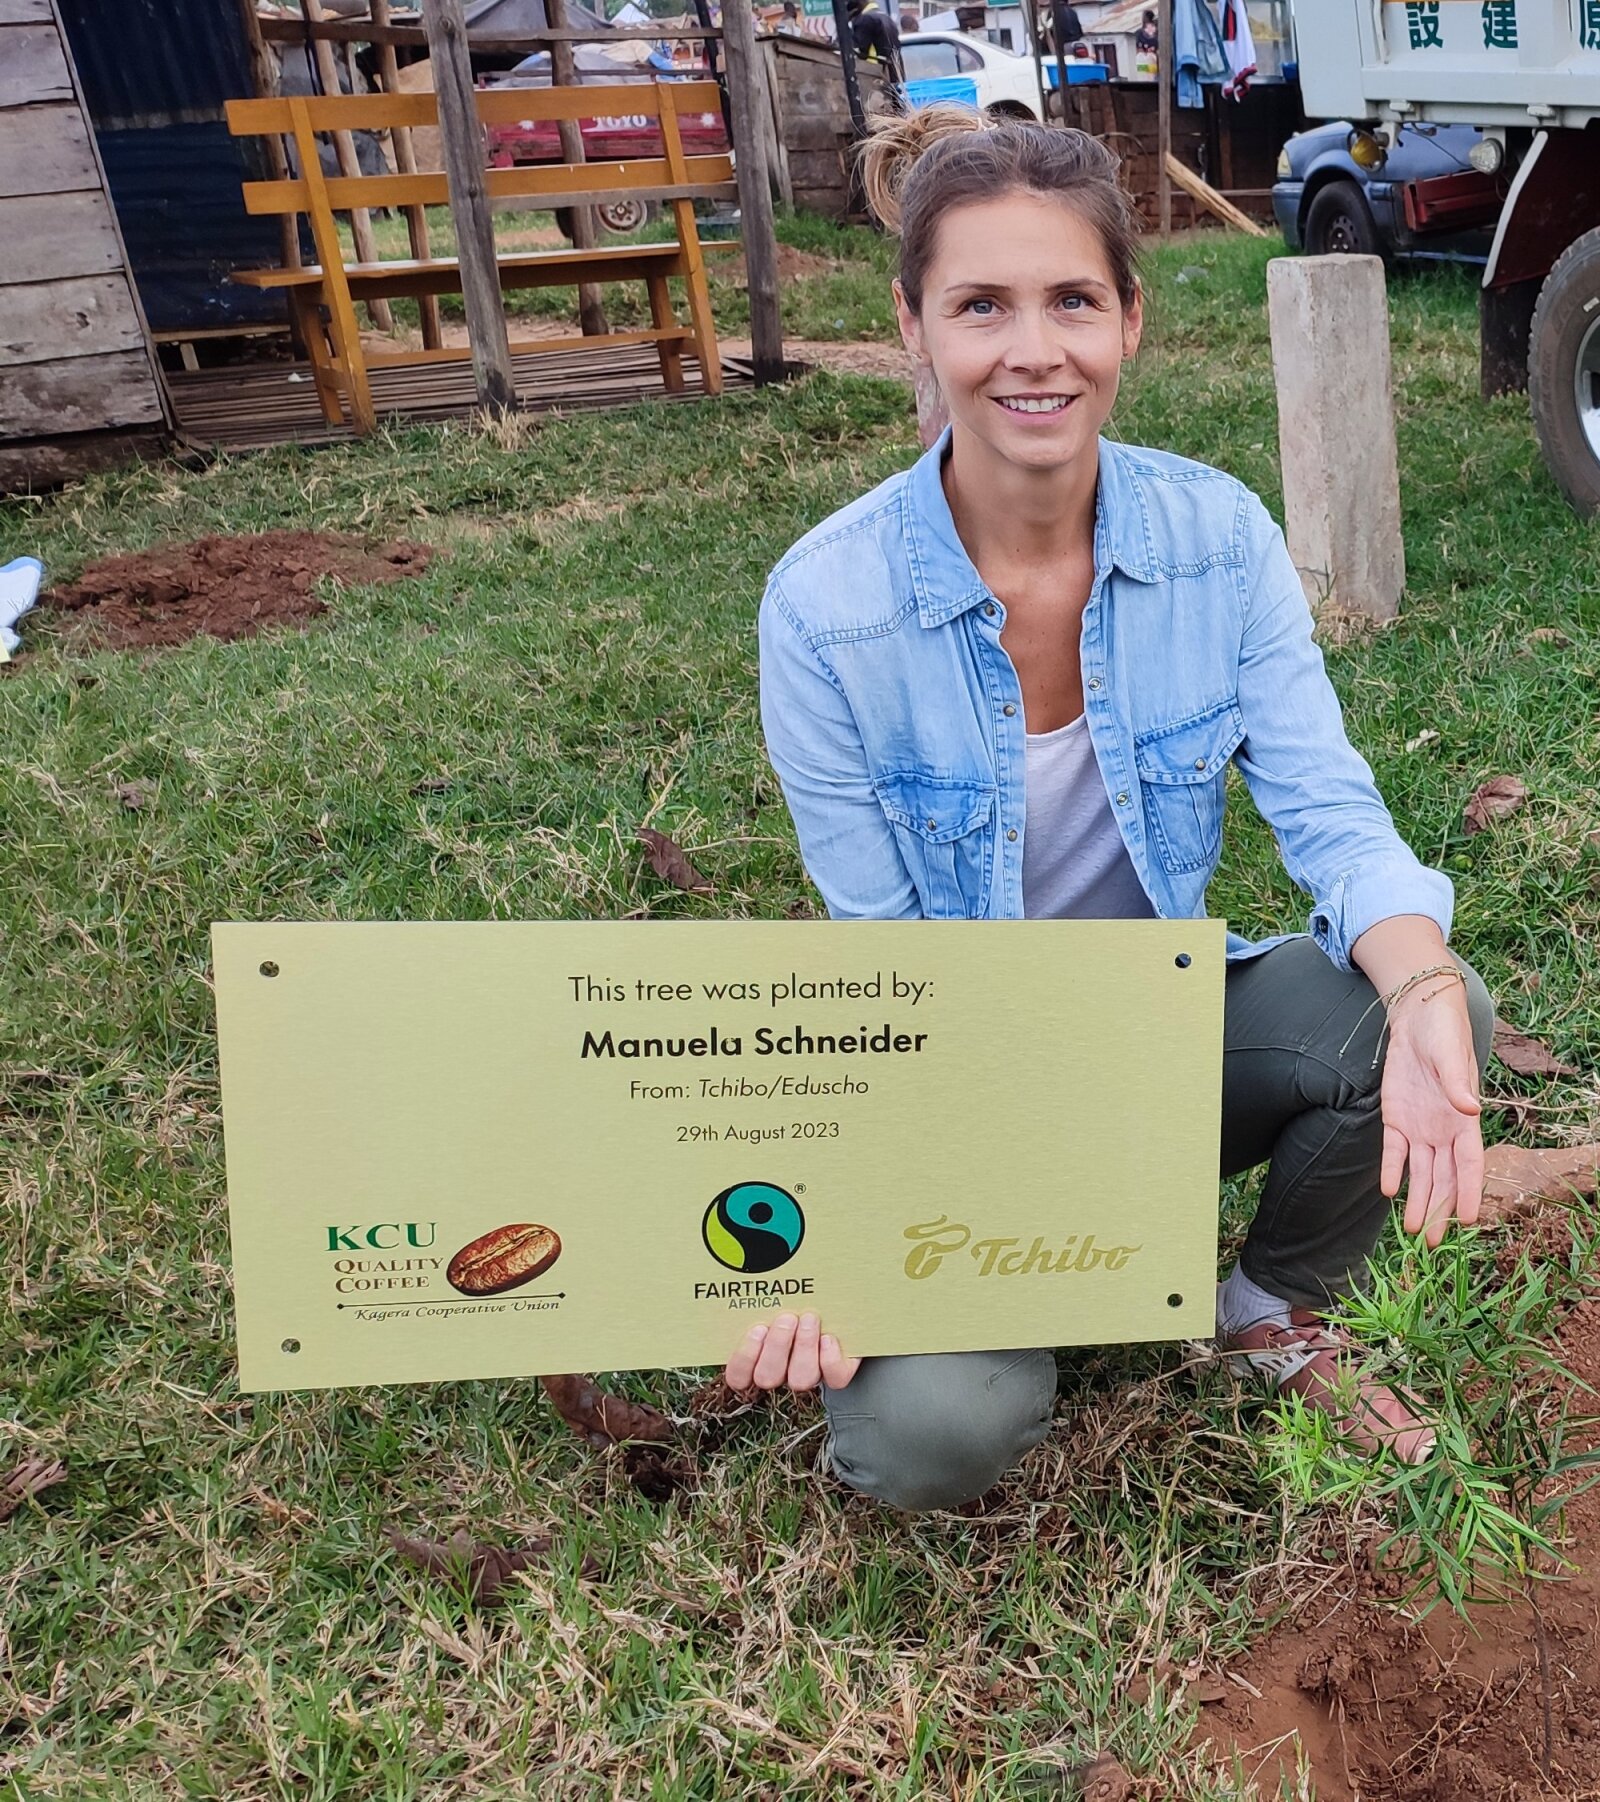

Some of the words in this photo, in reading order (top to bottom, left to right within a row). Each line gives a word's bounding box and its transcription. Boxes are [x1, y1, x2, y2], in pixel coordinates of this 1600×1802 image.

[567, 974, 626, 1002] This
[635, 977, 693, 1001] tree
[702, 980, 761, 1000] was
[771, 972, 882, 1008] planted
[892, 971, 935, 1006] by:
[580, 1026, 743, 1059] Manuela
[754, 1024, 928, 1056] Schneider
[629, 1080, 691, 1100] From:
[699, 1075, 870, 1100] Tchibo/Eduscho
[676, 1125, 719, 1143] 29th
[723, 1124, 786, 1145] August
[791, 1122, 840, 1140] 2023
[323, 1222, 438, 1252] KCU
[333, 1257, 444, 1275] QUALITY
[970, 1234, 1144, 1277] Tchibo
[335, 1276, 430, 1294] COFFEE
[694, 1278, 815, 1300] FAIRTRADE
[354, 1308, 410, 1322] Kagera
[416, 1303, 507, 1319] Cooperative
[510, 1299, 560, 1312] Union
[728, 1296, 781, 1310] AFRICA
